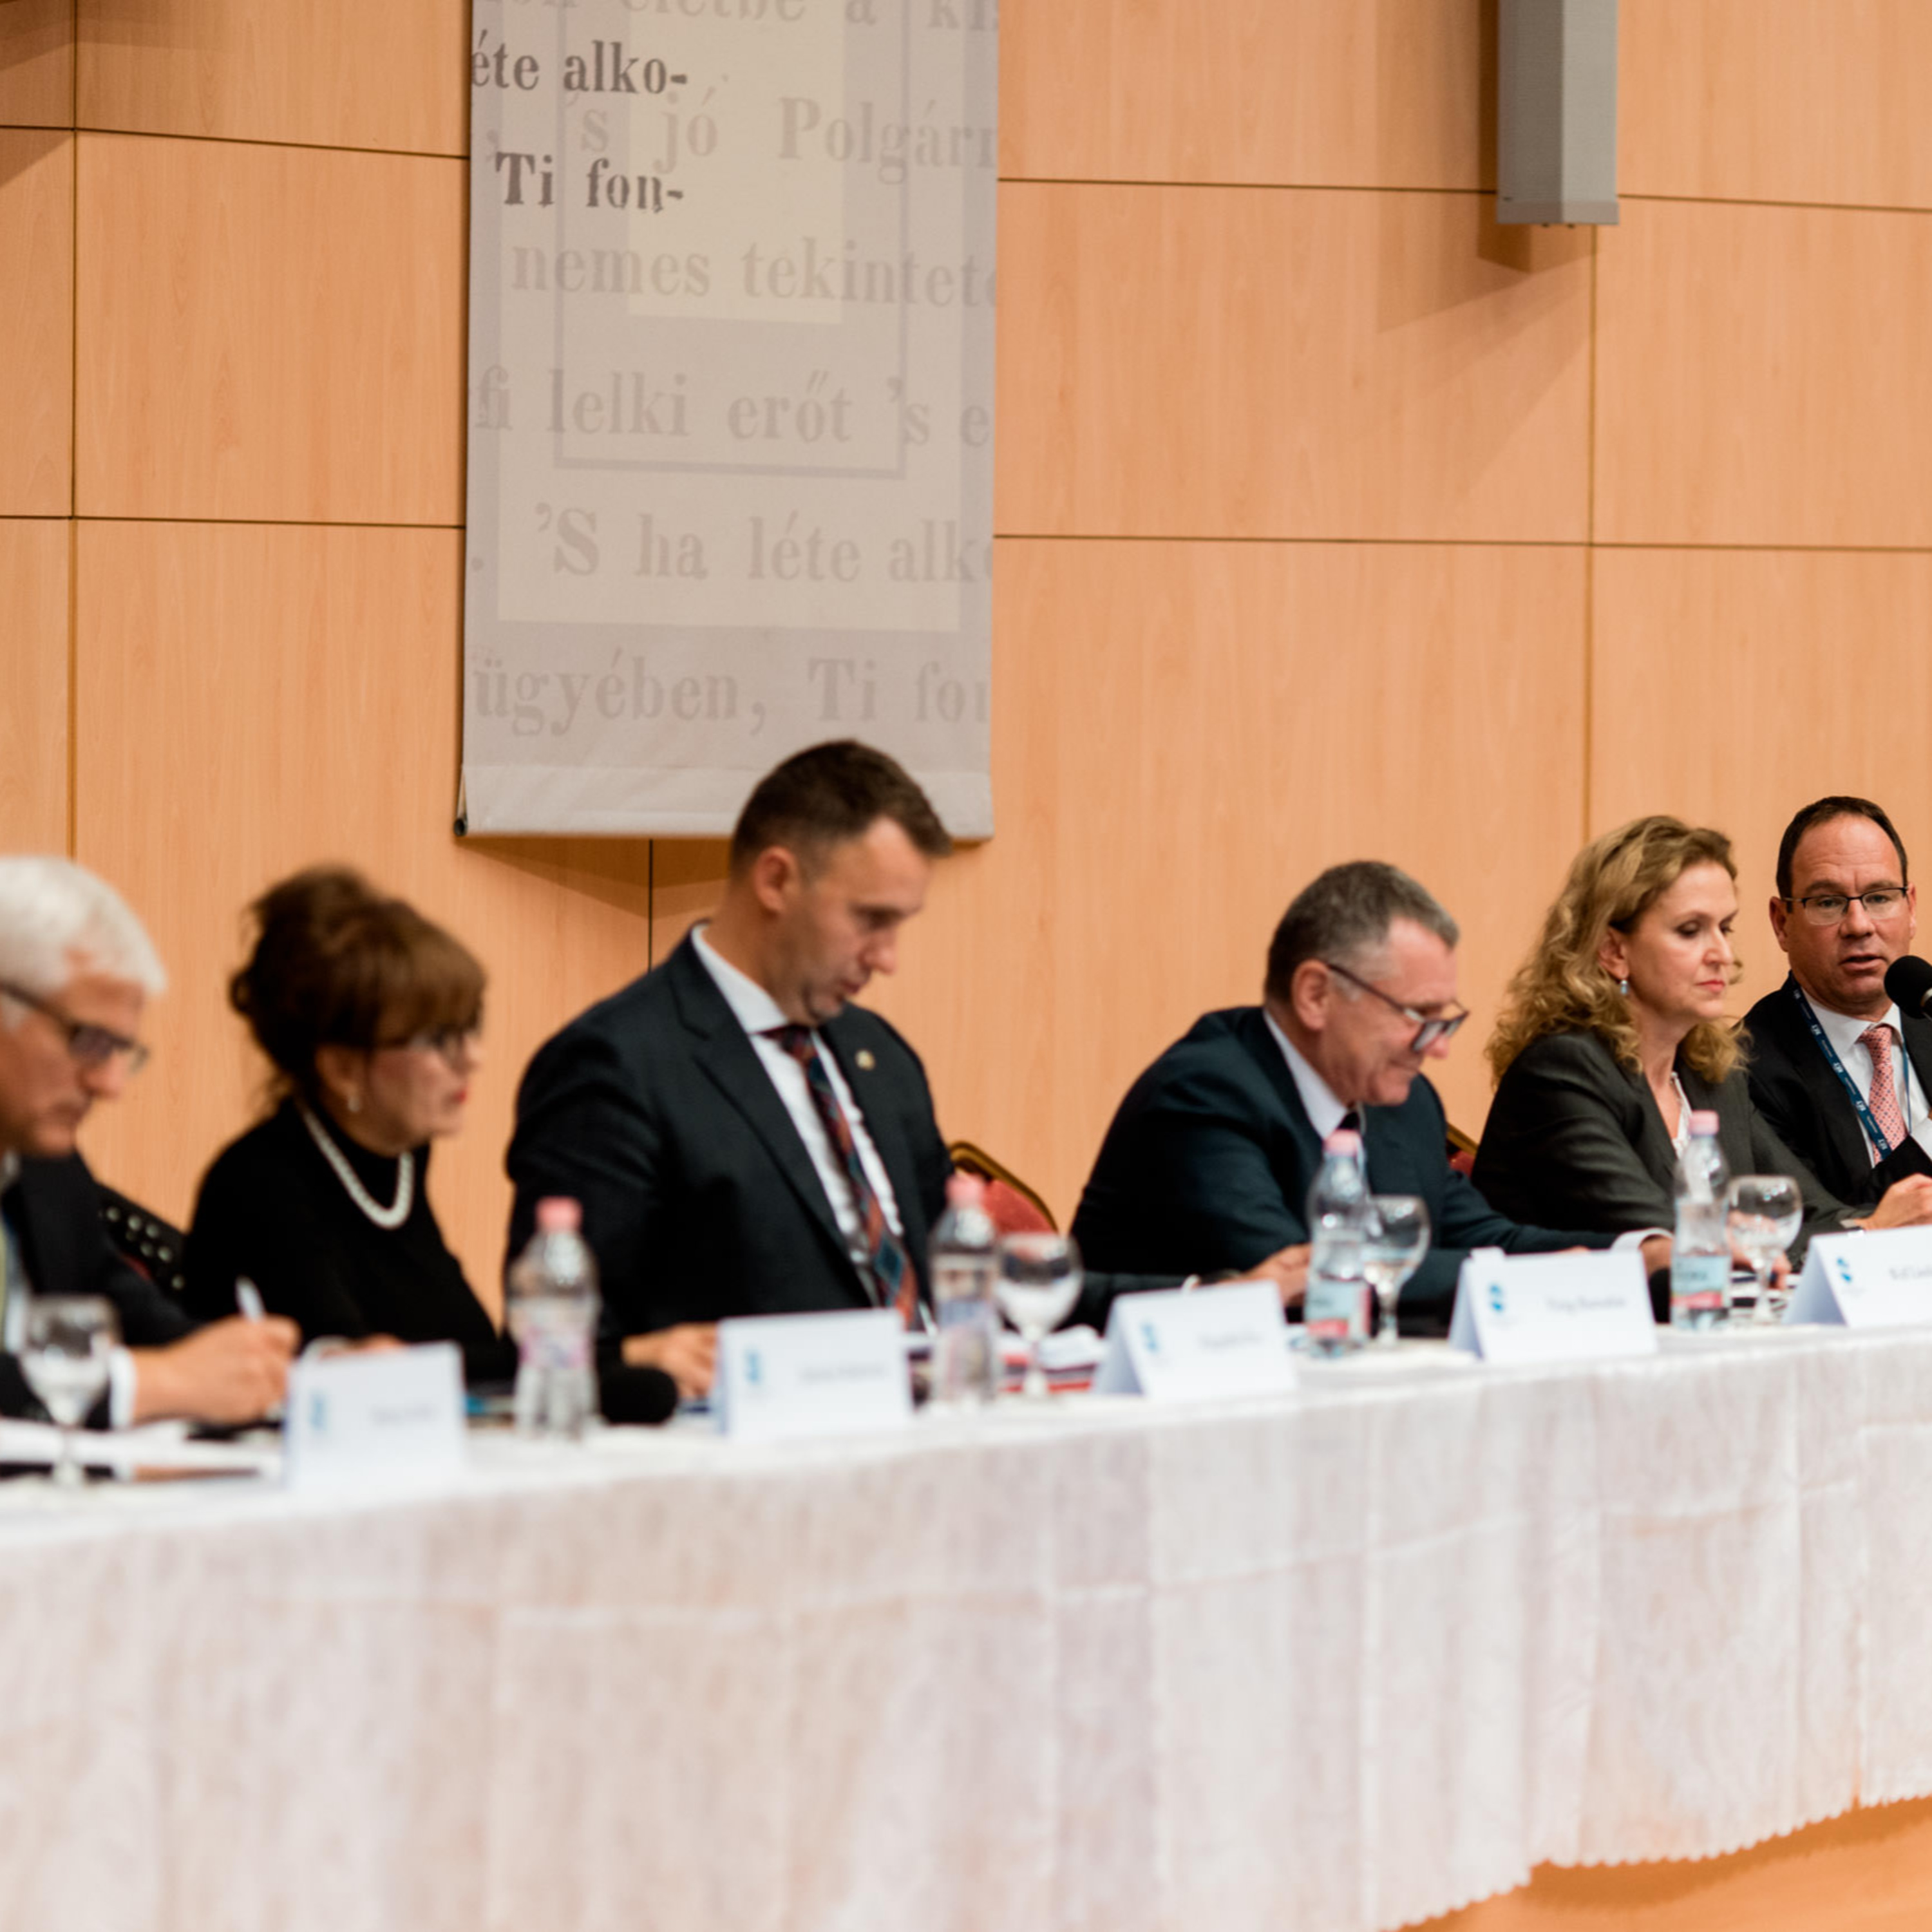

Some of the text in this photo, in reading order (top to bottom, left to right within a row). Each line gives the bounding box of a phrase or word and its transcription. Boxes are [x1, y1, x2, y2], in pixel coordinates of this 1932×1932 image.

[563, 39, 689, 95] alko-
[652, 86, 719, 174] jó
[495, 151, 685, 214] Ti fon-
[512, 246, 710, 297] nemes
[546, 368, 690, 437] lelki
[728, 369, 854, 444] erőt
[634, 513, 708, 580] ha
[748, 509, 862, 583] léte
[473, 645, 766, 737] ügyében,
[808, 656, 877, 723] Ti
